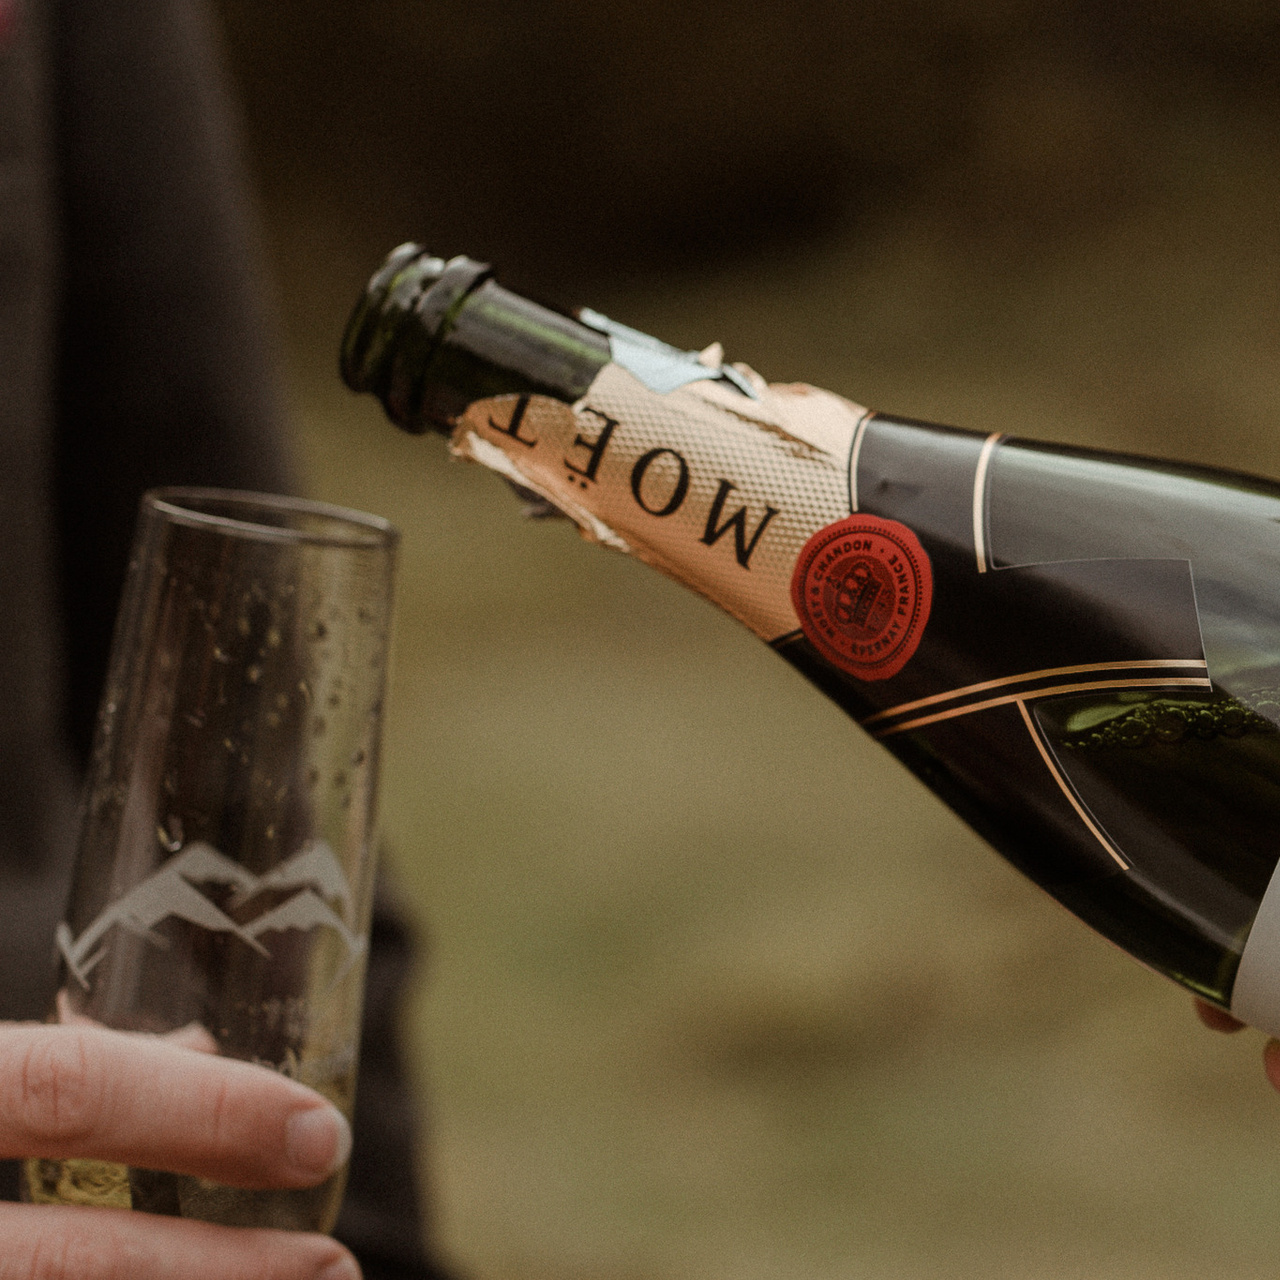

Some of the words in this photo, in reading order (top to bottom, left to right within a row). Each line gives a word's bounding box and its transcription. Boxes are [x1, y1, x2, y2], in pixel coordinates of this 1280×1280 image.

[489, 393, 779, 570] MOËT
[813, 540, 872, 581] CHANDON
[888, 554, 910, 616] FRANCE
